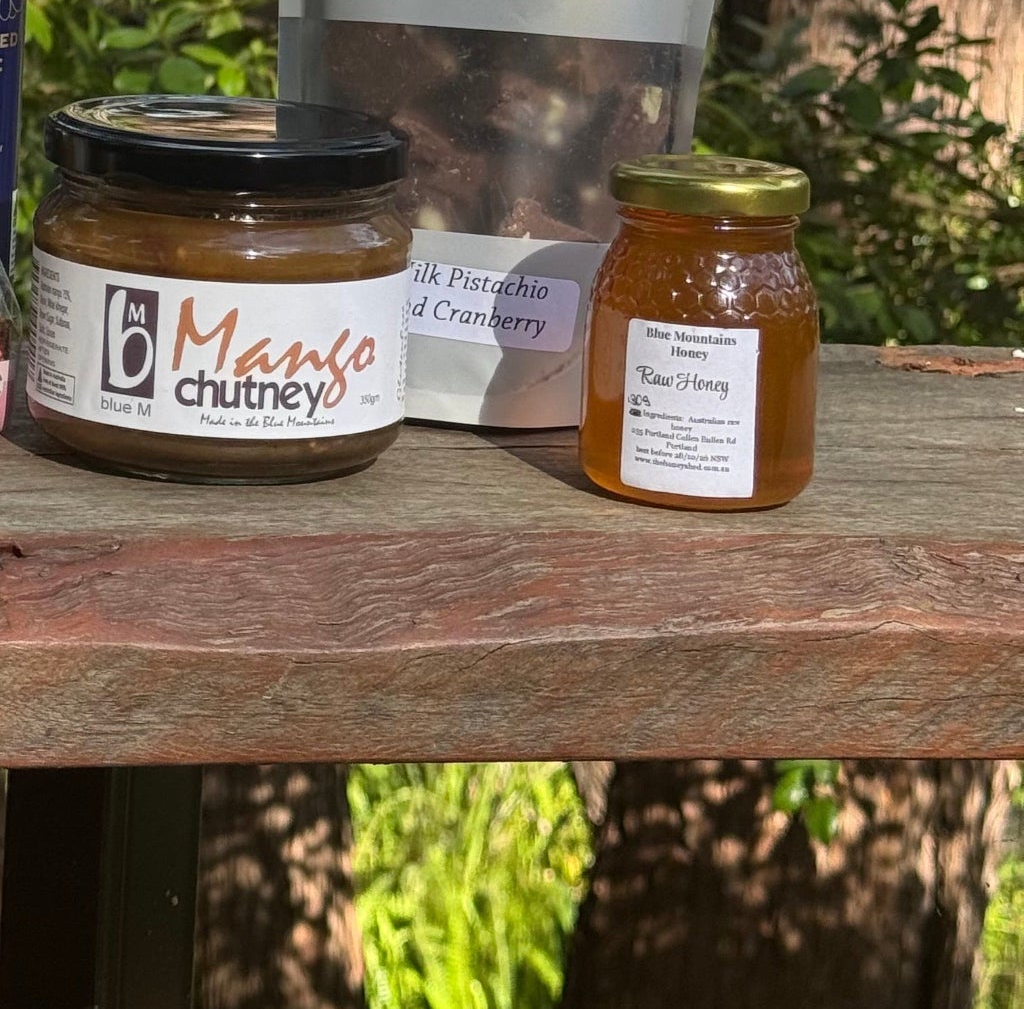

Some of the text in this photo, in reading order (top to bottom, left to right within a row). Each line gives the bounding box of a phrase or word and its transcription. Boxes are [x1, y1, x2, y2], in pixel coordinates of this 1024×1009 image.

[411, 261, 549, 300] ilk Pistachio
[434, 300, 546, 340] Cranberry
[646, 326, 737, 346] Blue Mountains
[171, 296, 376, 409] Mango
[671, 345, 709, 361] Honey
[636, 366, 729, 401] Raw Honey
[174, 370, 327, 419] chutney
[101, 396, 152, 418] blue M
[200, 412, 335, 429] Made in the Blue Mountains
[671, 422, 693, 433] honey
[688, 416, 725, 425] Australian
[645, 428, 674, 440] Portland
[726, 437, 737, 445] Rd
[651, 447, 673, 458] before
[710, 455, 729, 463] NSW
[666, 442, 698, 453] Portland
